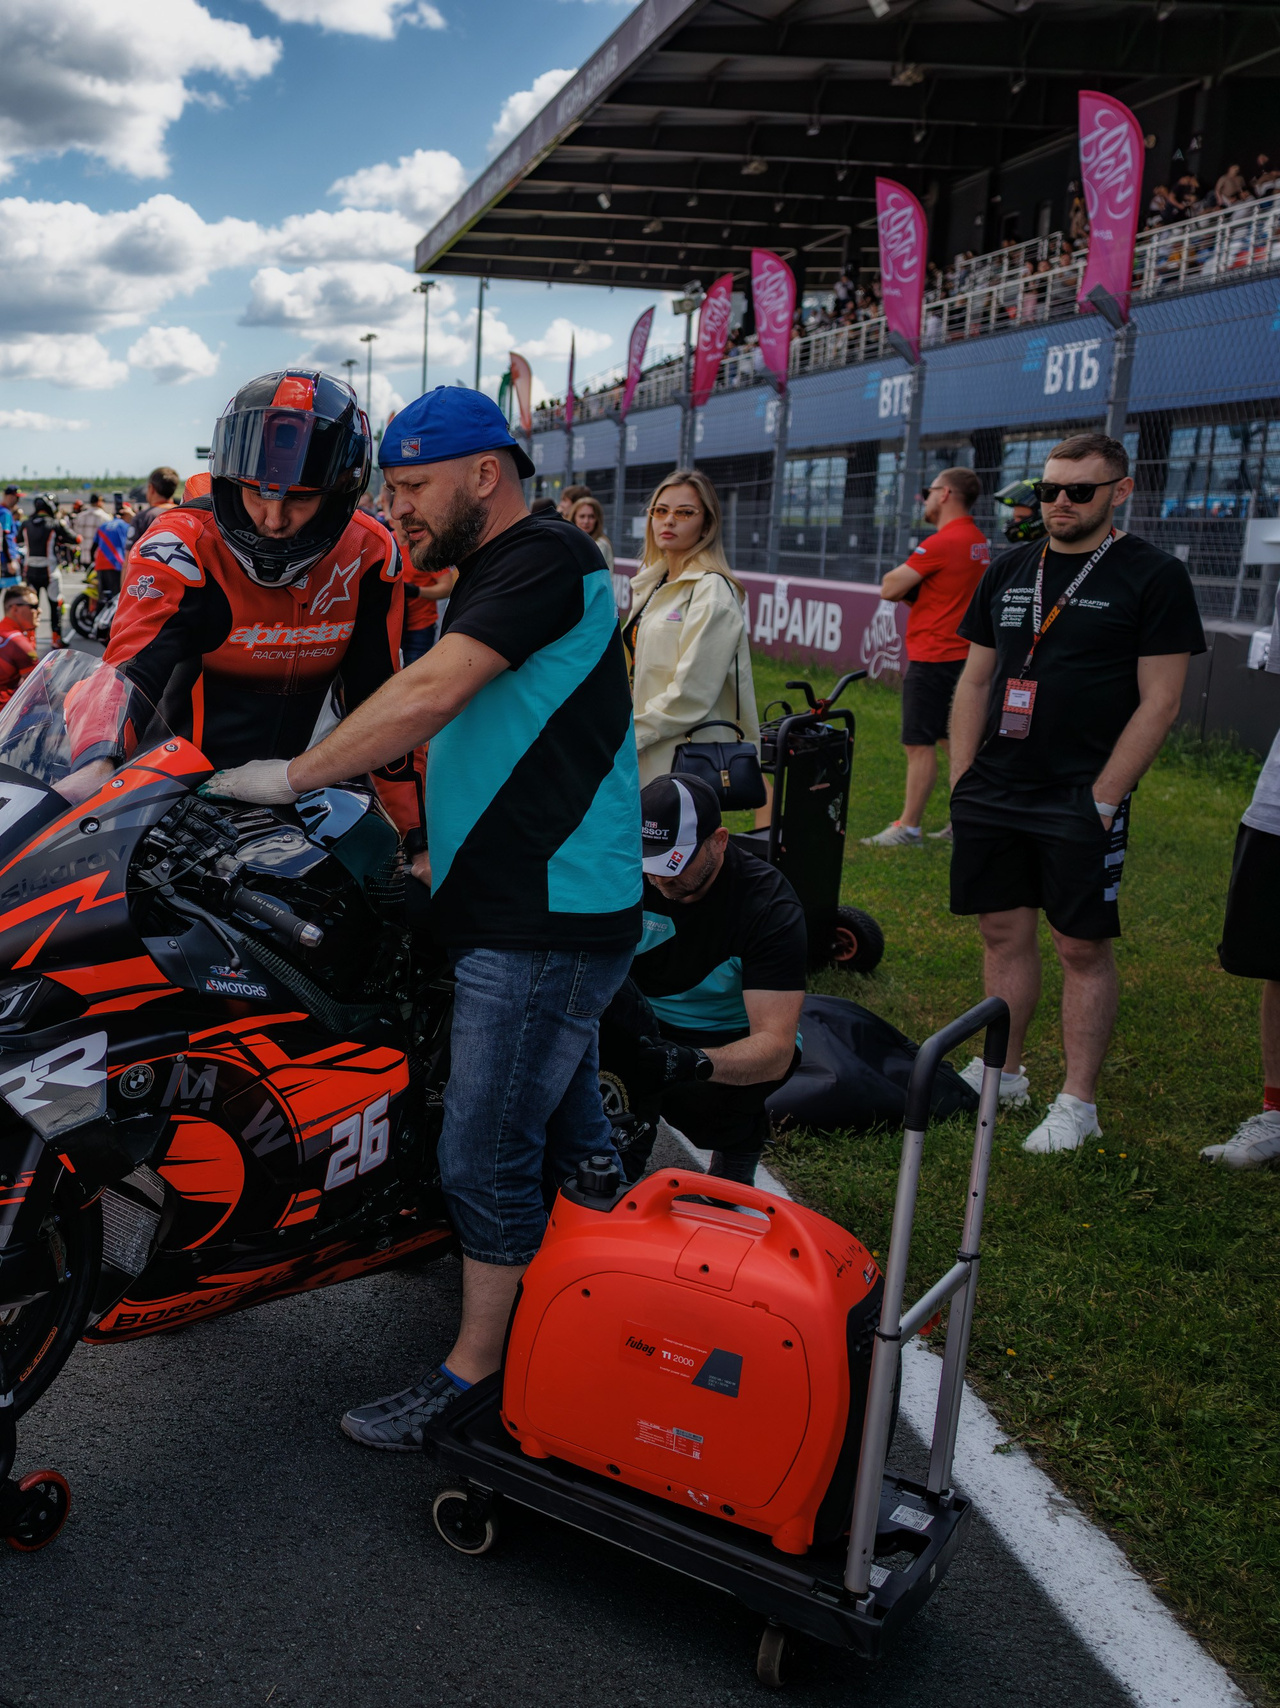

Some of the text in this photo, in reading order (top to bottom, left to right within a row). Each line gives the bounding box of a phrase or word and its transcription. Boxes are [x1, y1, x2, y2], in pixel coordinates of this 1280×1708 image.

[1043, 338, 1102, 395] ВТБ
[753, 591, 843, 653] ДРАЙВ
[228, 620, 356, 650] alpinestars
[251, 647, 337, 660] RACING AHEAD
[641, 827, 670, 837] ISSOT
[251, 895, 285, 917] domino
[323, 1090, 391, 1192] 26
[625, 1336, 657, 1357] Fubag
[661, 1350, 695, 1367] TI 2000
